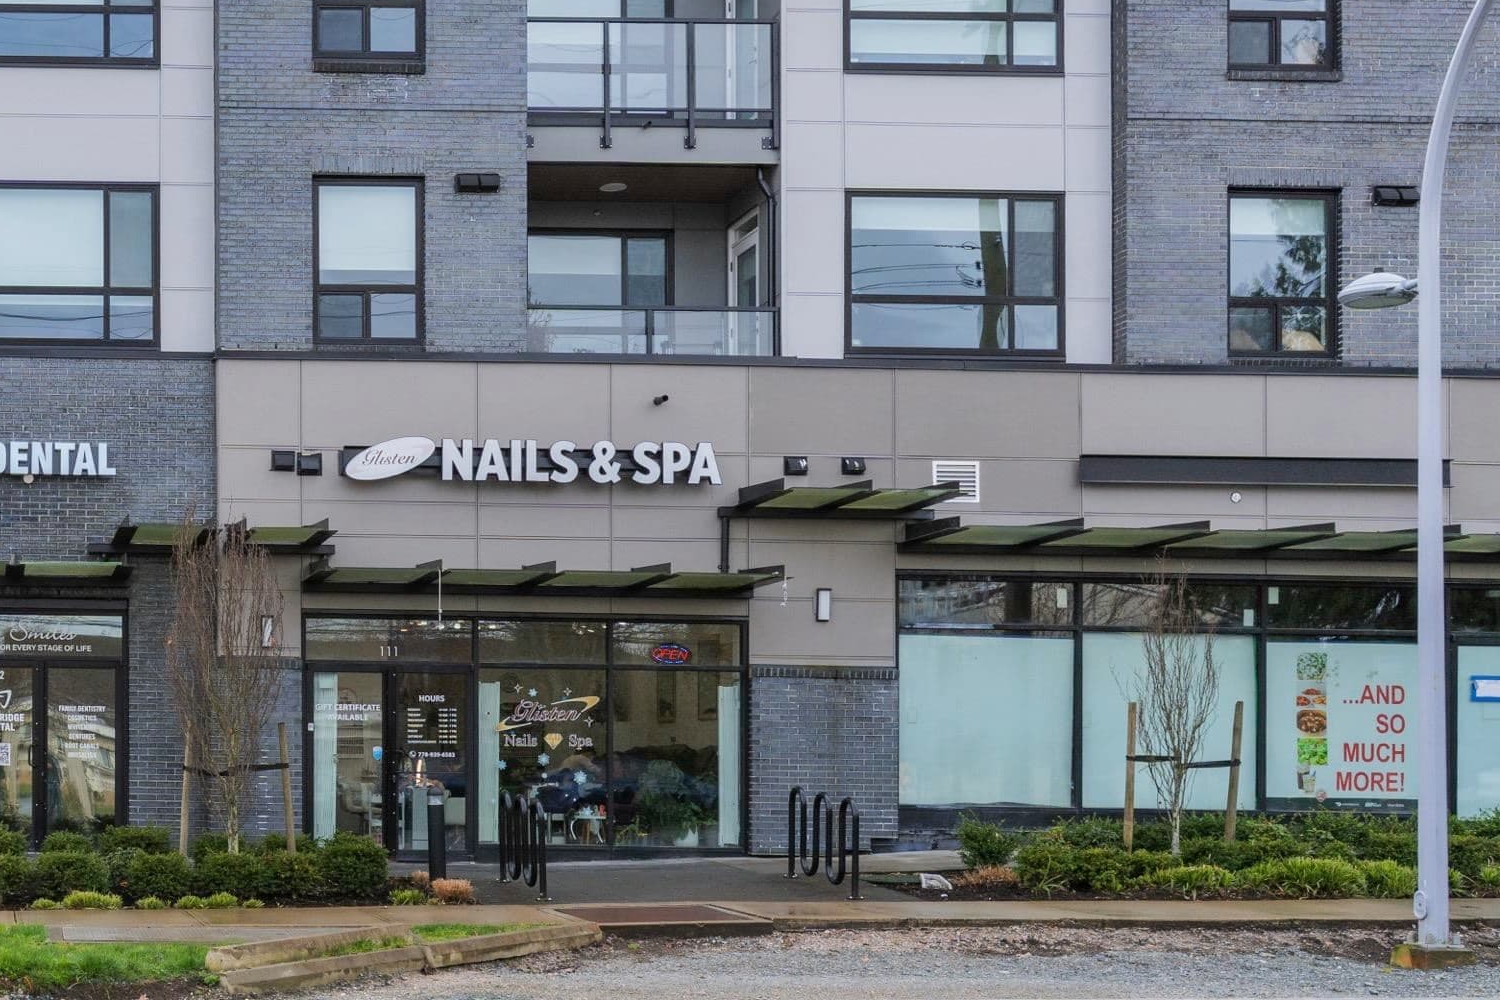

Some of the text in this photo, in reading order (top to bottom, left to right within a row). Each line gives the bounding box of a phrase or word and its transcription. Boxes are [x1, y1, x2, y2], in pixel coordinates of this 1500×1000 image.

[361, 448, 417, 465] Glisten
[442, 438, 723, 485] NAILS & SPA
[9, 620, 77, 641] Smiles
[12, 643, 37, 651] EVERY
[37, 644, 63, 652] STAGE
[380, 646, 398, 657] 111
[652, 648, 689, 661] OPEN
[1343, 684, 1405, 705] ...AND
[316, 703, 381, 711] GIFT CERTIFICATE
[511, 698, 582, 722] Glisten
[1376, 714, 1405, 734] SO
[503, 734, 593, 749] Nails Spa
[1343, 743, 1405, 763] MUCH
[1336, 772, 1404, 792] MORE!
